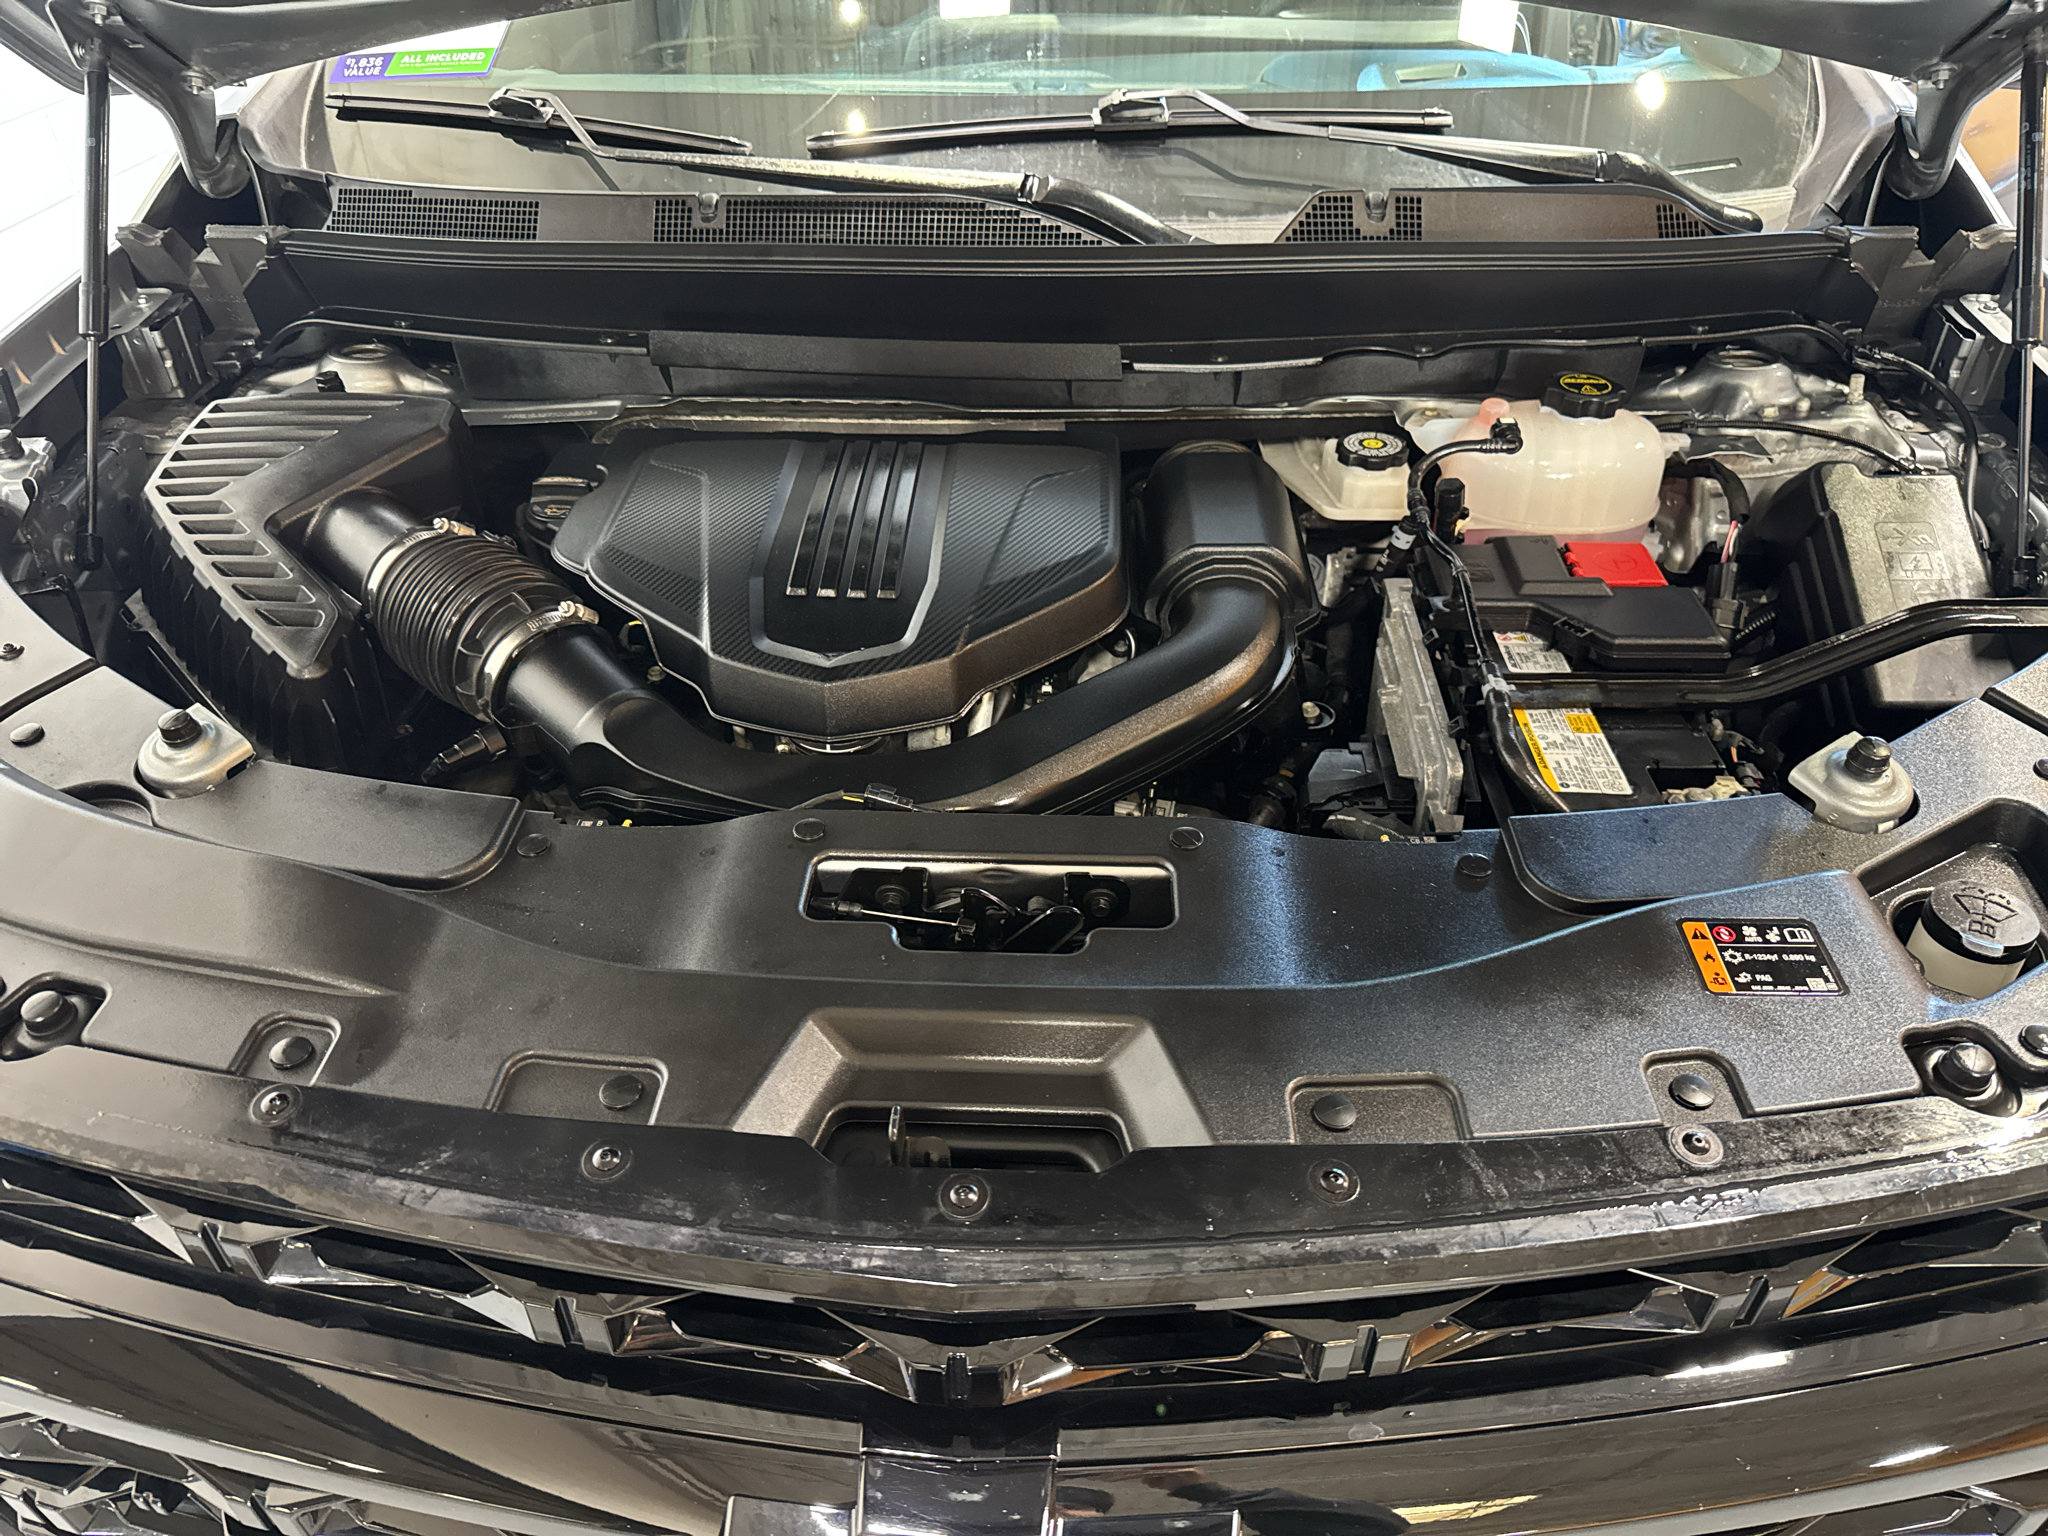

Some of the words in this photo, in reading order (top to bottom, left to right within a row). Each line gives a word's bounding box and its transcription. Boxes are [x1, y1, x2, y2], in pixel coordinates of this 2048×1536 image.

[401, 54, 422, 63] ALL
[425, 52, 486, 62] INCLUDED
[344, 67, 381, 77] VALUE
[1804, 954, 1816, 962] kg
[1755, 974, 1773, 982] PAG
